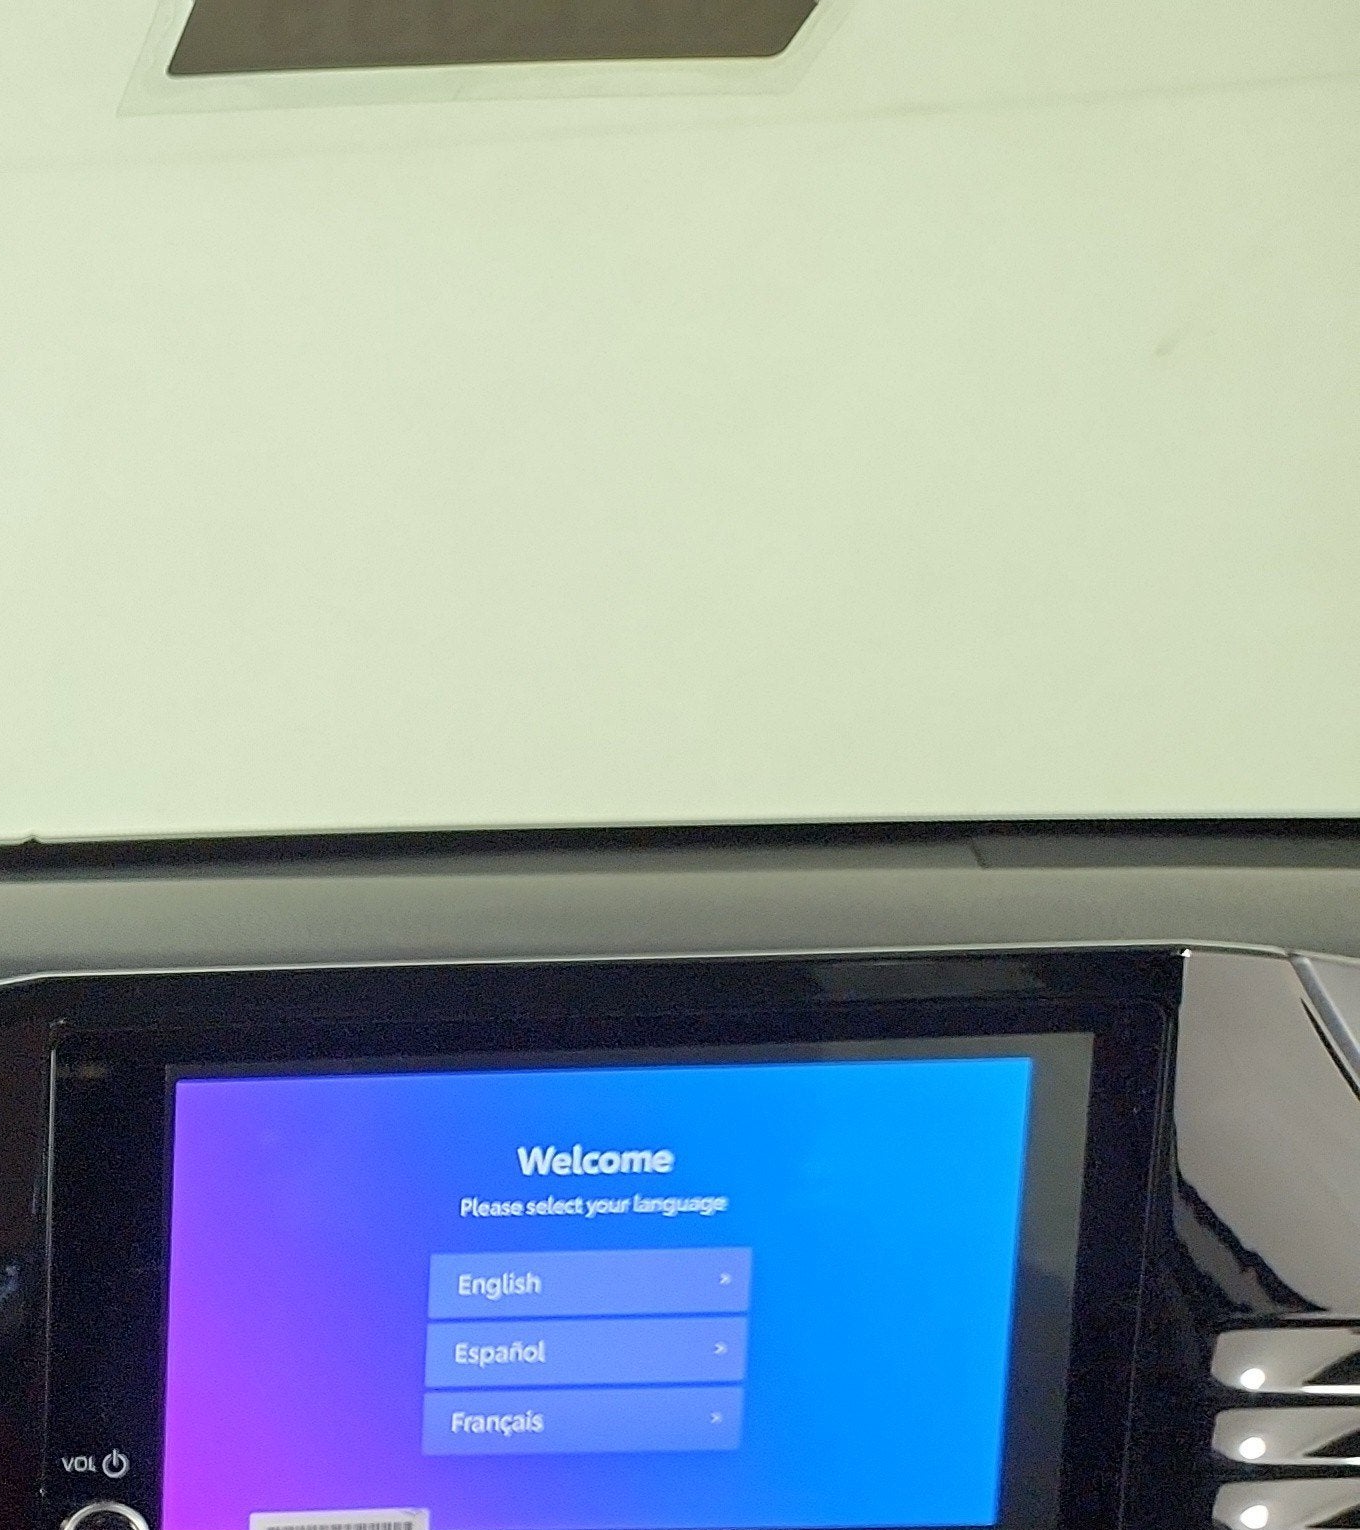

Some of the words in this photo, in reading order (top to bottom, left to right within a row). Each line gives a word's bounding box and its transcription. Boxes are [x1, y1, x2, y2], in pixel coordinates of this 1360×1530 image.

[517, 1145, 675, 1176] Welcome
[460, 1198, 523, 1217] Please
[525, 1197, 583, 1216] select
[586, 1199, 630, 1218] your
[634, 1195, 729, 1218] language
[458, 1272, 542, 1301] English
[454, 1340, 546, 1368] Español
[450, 1410, 545, 1437] Français
[62, 1456, 96, 1473] VOL
